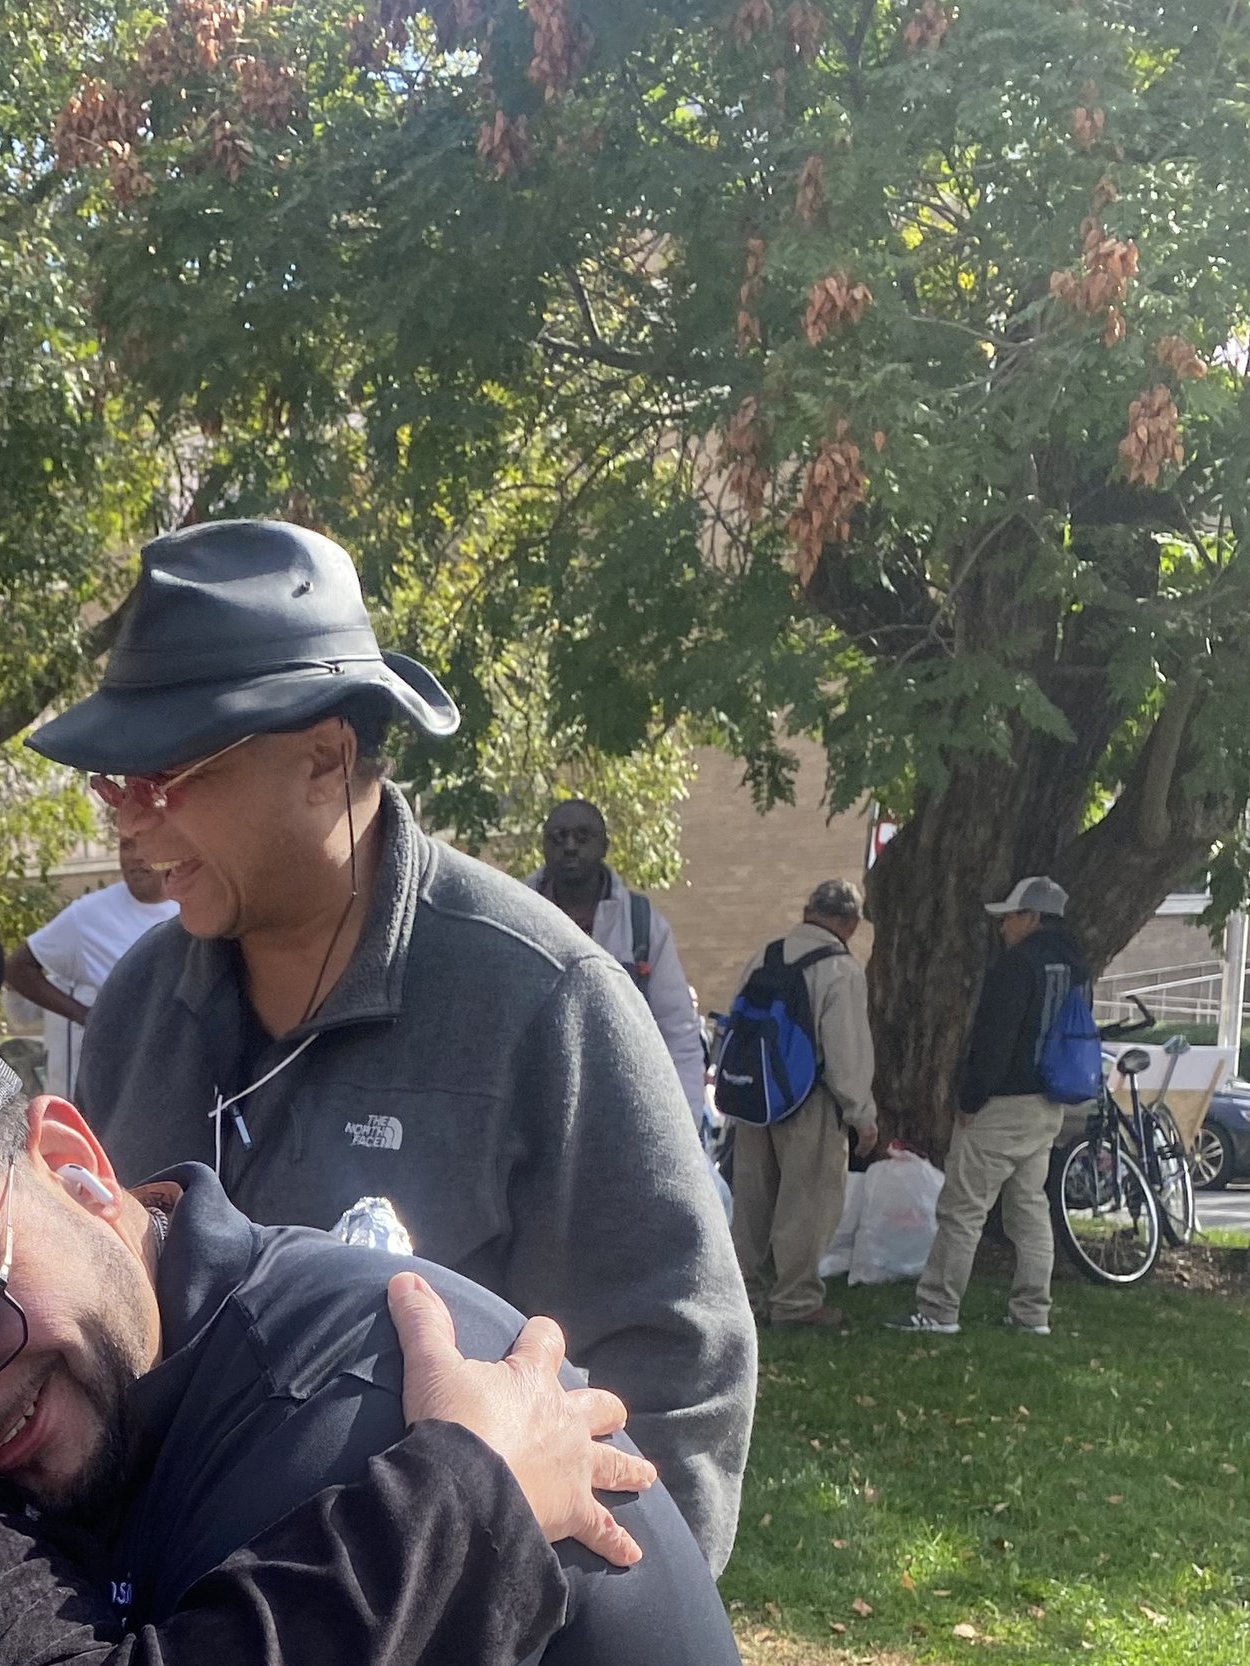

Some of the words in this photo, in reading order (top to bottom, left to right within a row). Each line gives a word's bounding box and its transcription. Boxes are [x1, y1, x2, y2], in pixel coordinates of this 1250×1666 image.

[368, 1115, 389, 1127] THE
[345, 1122, 384, 1137] NORTH
[352, 1135, 382, 1148] FACE
